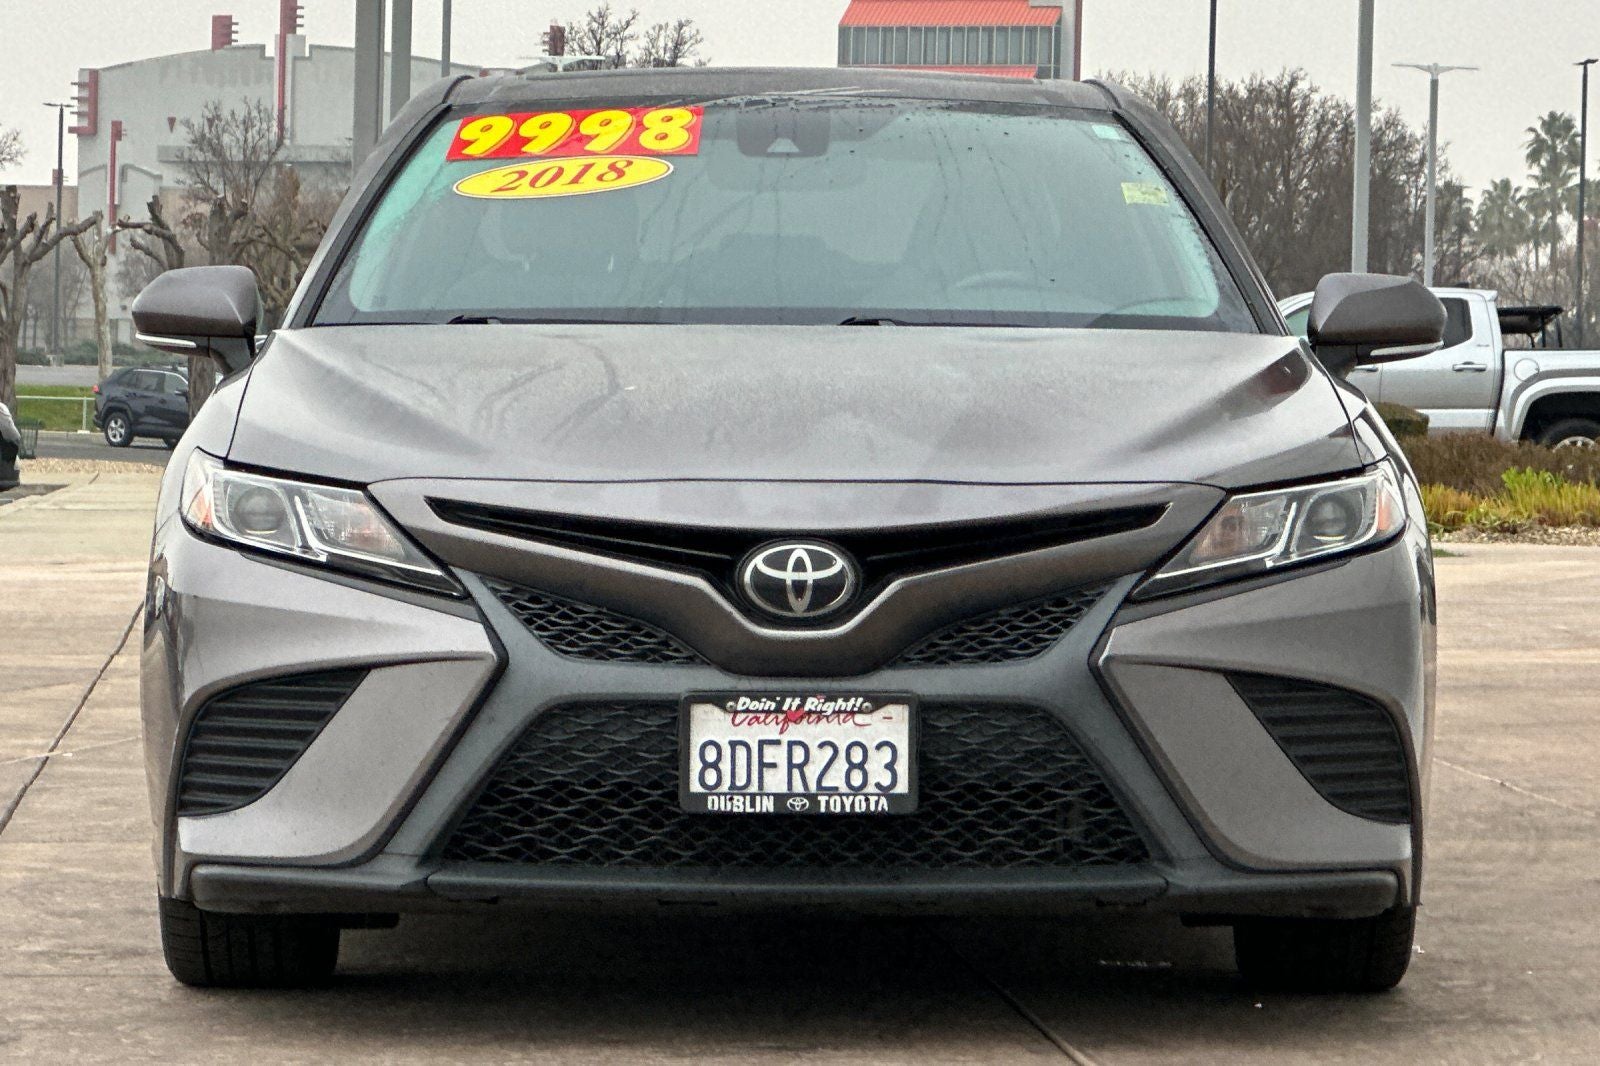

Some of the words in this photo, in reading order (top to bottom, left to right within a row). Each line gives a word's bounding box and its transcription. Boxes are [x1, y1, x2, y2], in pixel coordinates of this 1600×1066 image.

[460, 107, 698, 157] 9998
[490, 159, 634, 193] 2018
[736, 696, 780, 712] Doin'
[782, 697, 801, 712] It
[804, 697, 864, 716] Right!
[698, 738, 898, 793] 8DFR283
[707, 795, 774, 813] DUBLIN
[817, 795, 889, 813] TOYOTA
